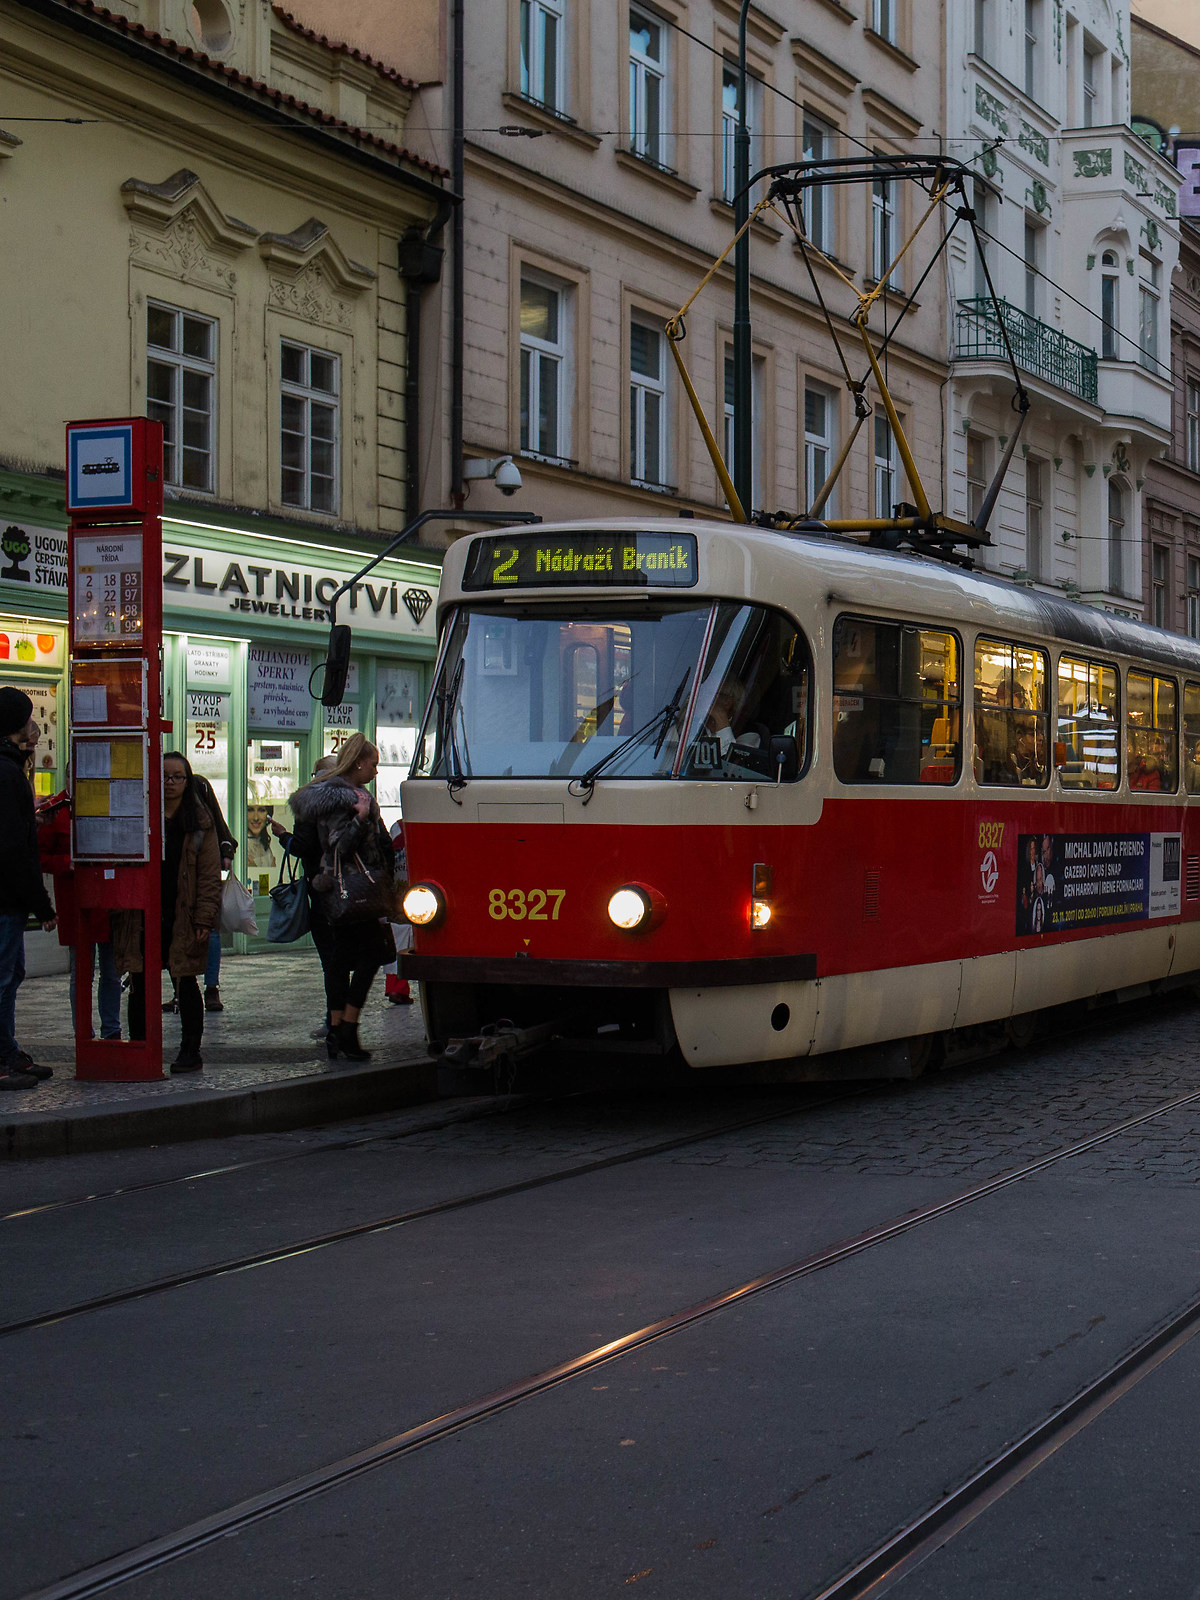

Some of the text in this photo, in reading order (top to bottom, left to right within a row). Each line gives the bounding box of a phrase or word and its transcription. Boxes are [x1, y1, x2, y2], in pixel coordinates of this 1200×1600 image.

[4, 540, 29, 555] UGO
[97, 543, 124, 553] NÁRODNÍ
[101, 553, 119, 563] TŘÍDA
[493, 545, 688, 584] 2 Nádraží Braník
[86, 573, 138, 587] 2 18 93
[163, 551, 398, 615] ZLATNICTVÍ
[86, 588, 138, 603] 9 22 97
[125, 604, 138, 617] 98
[230, 598, 333, 622] JEWELLERY
[104, 621, 116, 633] 41
[257, 663, 297, 681] ŠPERKY
[191, 693, 222, 706] VÝKUP
[192, 706, 220, 718] ZLATA
[327, 715, 352, 725] ZLATA
[195, 729, 216, 750] 25
[978, 822, 1005, 849] 8327
[1065, 841, 1092, 859] MICHAL
[1093, 841, 1112, 858] DAVID
[1119, 840, 1145, 857] FRIENDS
[1064, 863, 1121, 879] GAZEBO OPUS SNAP
[1063, 884, 1075, 898] DEN
[1076, 882, 1099, 896] HARROW
[1101, 880, 1116, 894] IRENE
[488, 888, 567, 921] 8327
